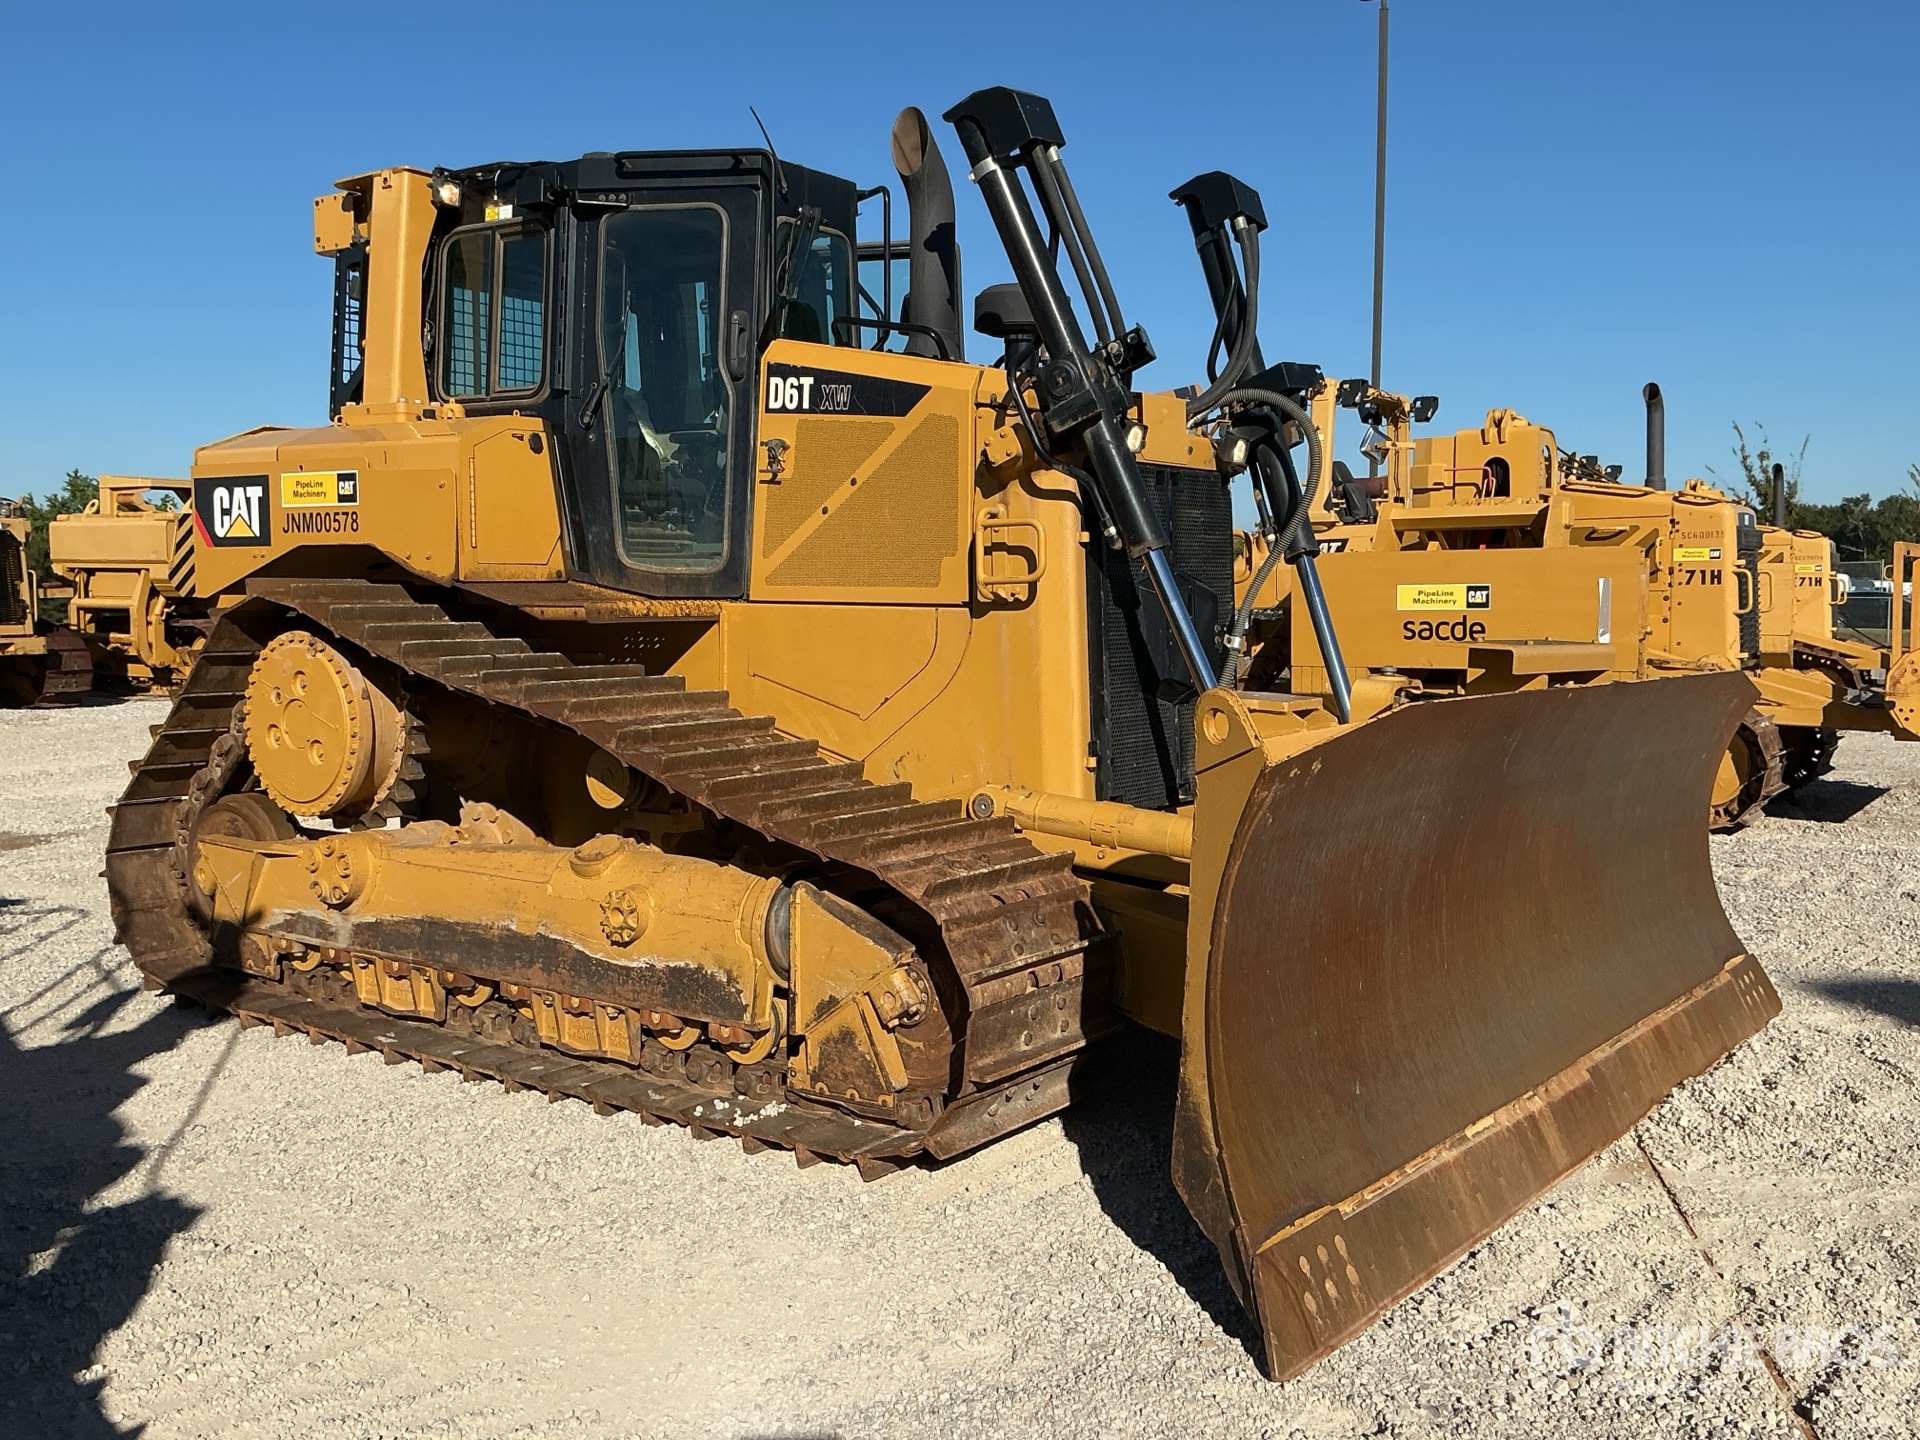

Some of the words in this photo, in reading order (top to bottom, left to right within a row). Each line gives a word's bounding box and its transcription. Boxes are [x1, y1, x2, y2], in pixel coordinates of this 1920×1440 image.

[768, 376, 814, 410] D6T
[820, 385, 851, 410] XW
[295, 480, 324, 490] PipeLine
[338, 480, 355, 495] CAT
[293, 489, 327, 499] Machinery
[213, 486, 263, 537] CAT
[282, 511, 359, 533] JNM00578
[1319, 542, 1342, 553] AT
[1685, 569, 1722, 585] 71H
[1798, 576, 1822, 587] 71H
[1417, 590, 1454, 598] PipeLine
[1468, 590, 1489, 603] CAT
[1402, 614, 1486, 642] sacde
